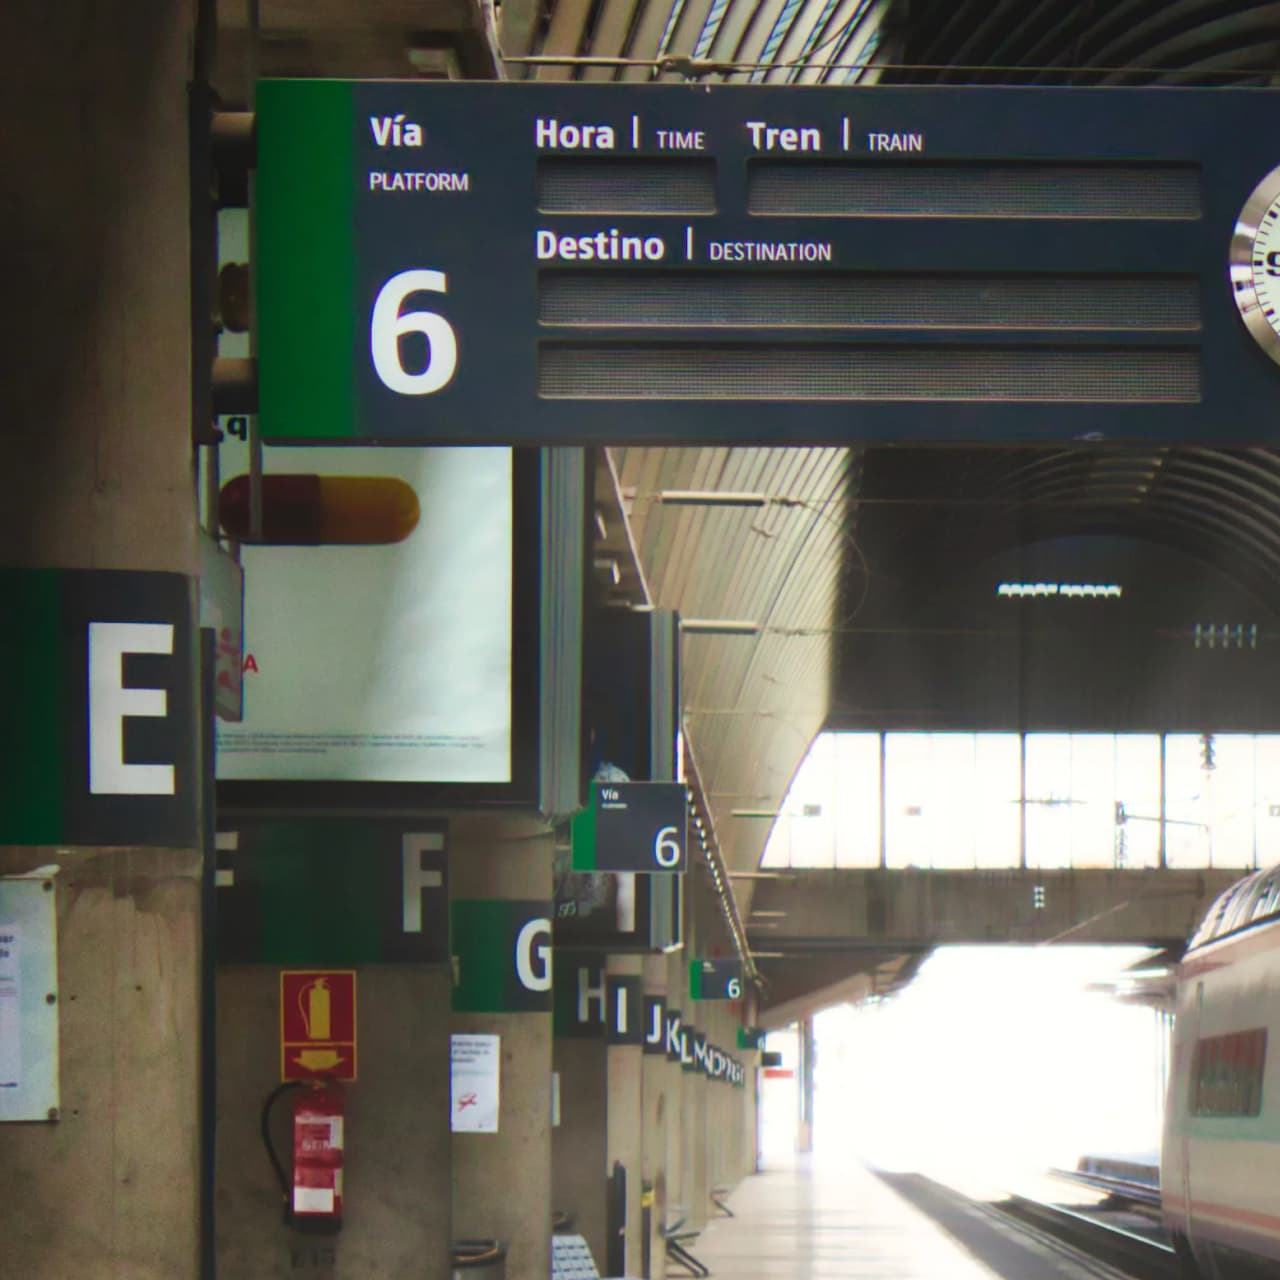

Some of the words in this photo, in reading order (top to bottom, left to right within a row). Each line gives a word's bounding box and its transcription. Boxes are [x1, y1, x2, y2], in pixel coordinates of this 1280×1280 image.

[370, 114, 422, 147] Vía
[535, 119, 615, 149] Hora
[656, 130, 705, 150] TIME
[746, 121, 821, 151] Tren
[868, 133, 922, 151] TRAIN
[369, 172, 469, 191] PLATFORM
[536, 228, 665, 260] Destino
[710, 242, 831, 261] DESTINATION
[370, 269, 457, 395] 6
[88, 622, 175, 795] E
[655, 826, 680, 867] 6
[402, 833, 444, 932] F
[516, 918, 552, 991] G
[728, 978, 741, 999] 6
[646, 1004, 662, 1043] J
[666, 1018, 681, 1053] K
[681, 1031, 693, 1063] L
